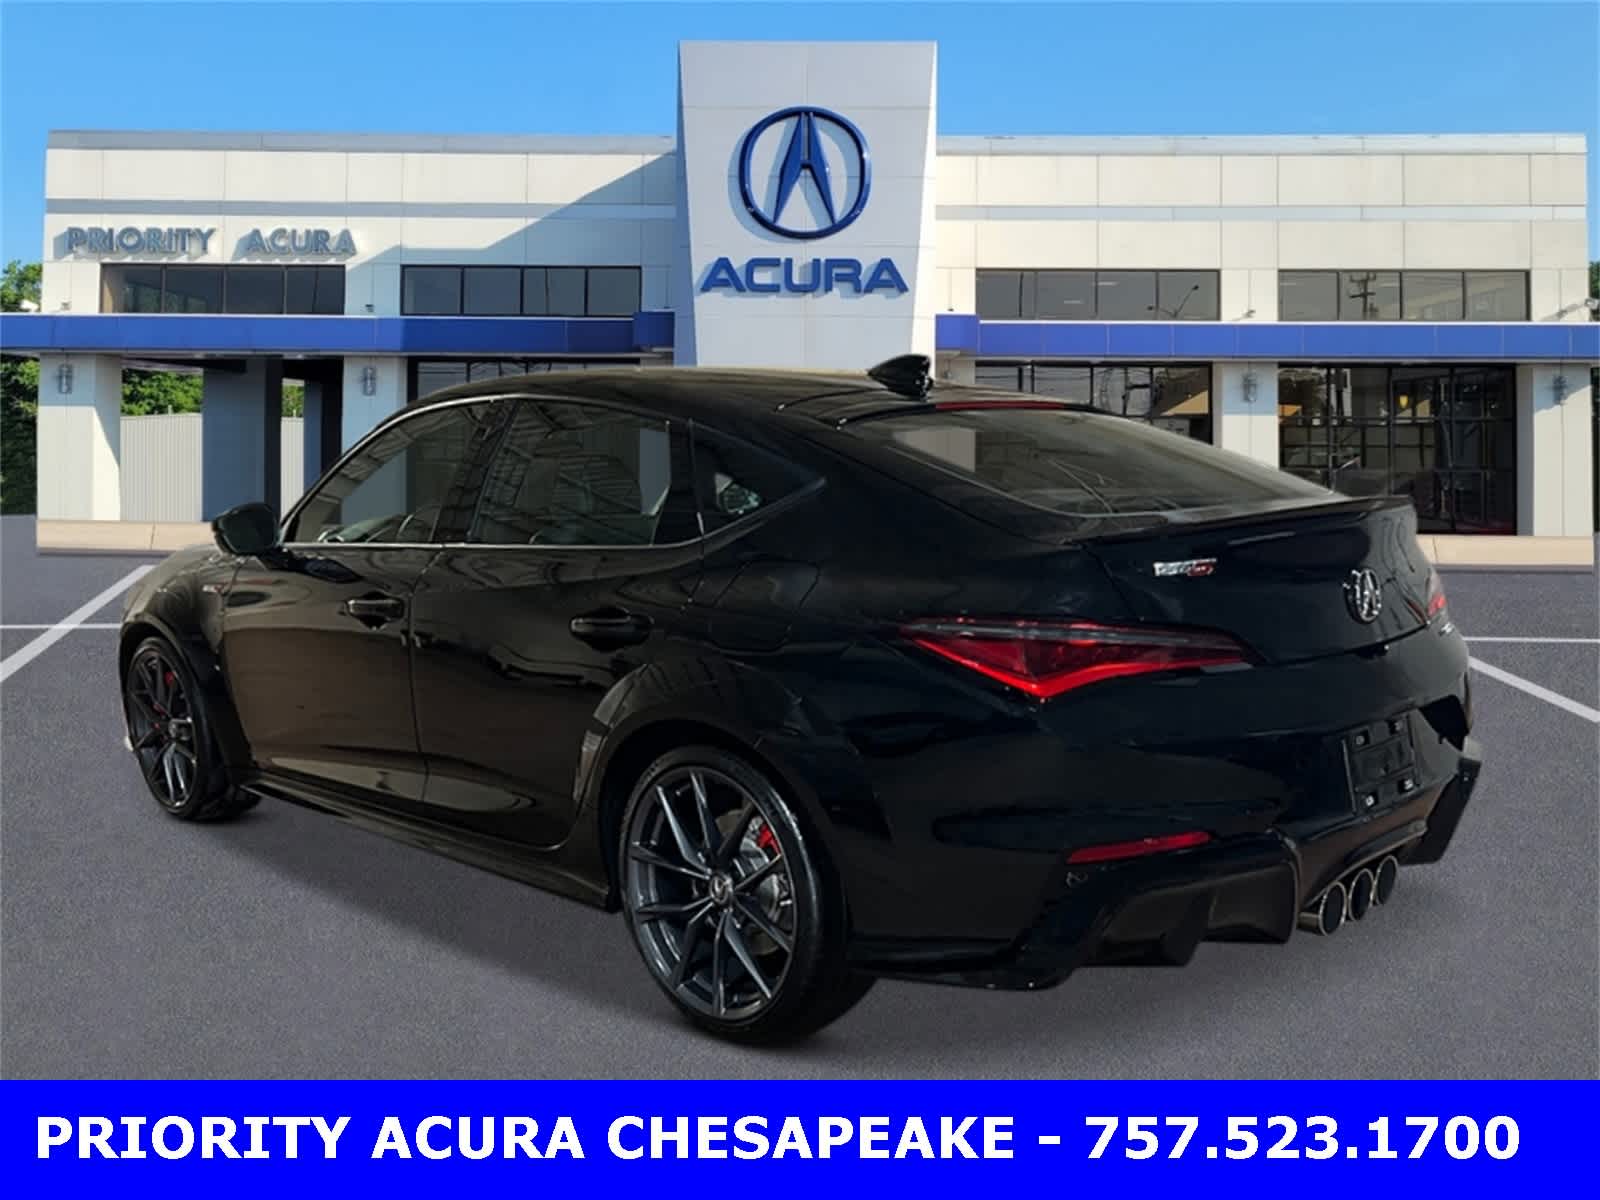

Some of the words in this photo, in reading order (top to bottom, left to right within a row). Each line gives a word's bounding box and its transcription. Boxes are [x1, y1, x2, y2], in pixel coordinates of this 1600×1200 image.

[67, 226, 216, 254] PRIORITY
[246, 227, 358, 256] ACURA
[700, 257, 909, 294] ACURA
